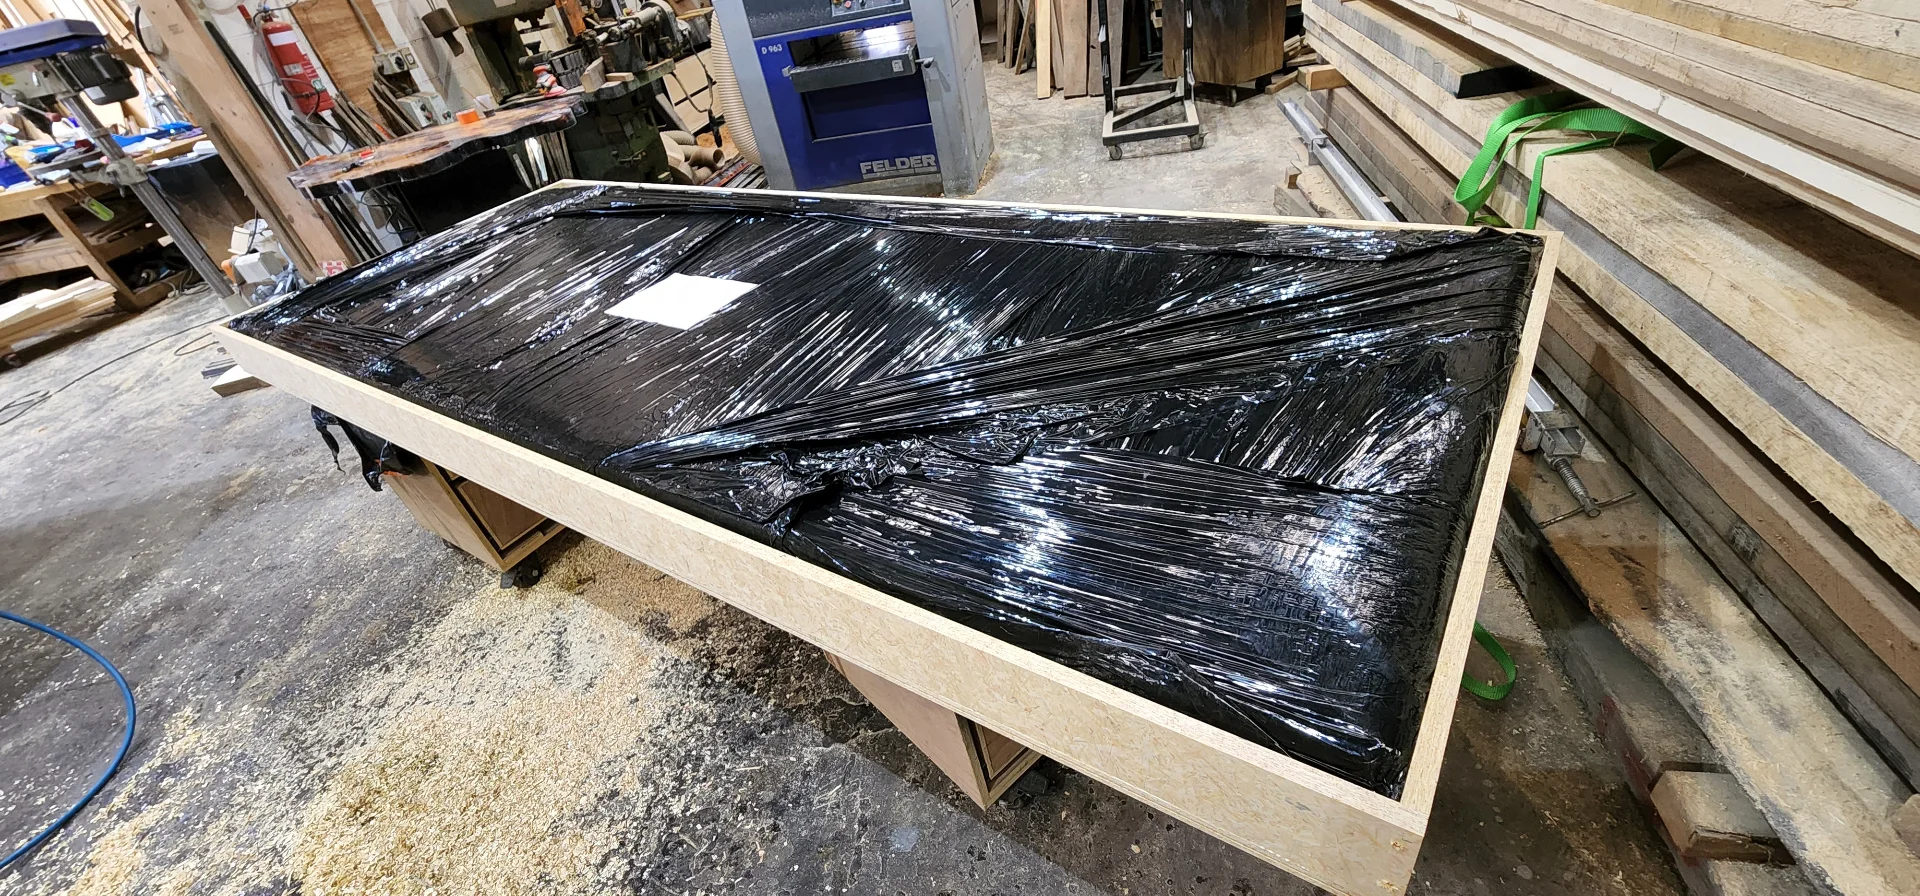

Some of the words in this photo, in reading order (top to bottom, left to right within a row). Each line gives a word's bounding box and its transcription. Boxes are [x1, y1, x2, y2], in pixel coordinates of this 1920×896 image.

[761, 46, 768, 55] D
[768, 43, 783, 53] 963
[860, 154, 937, 174] FELDER
